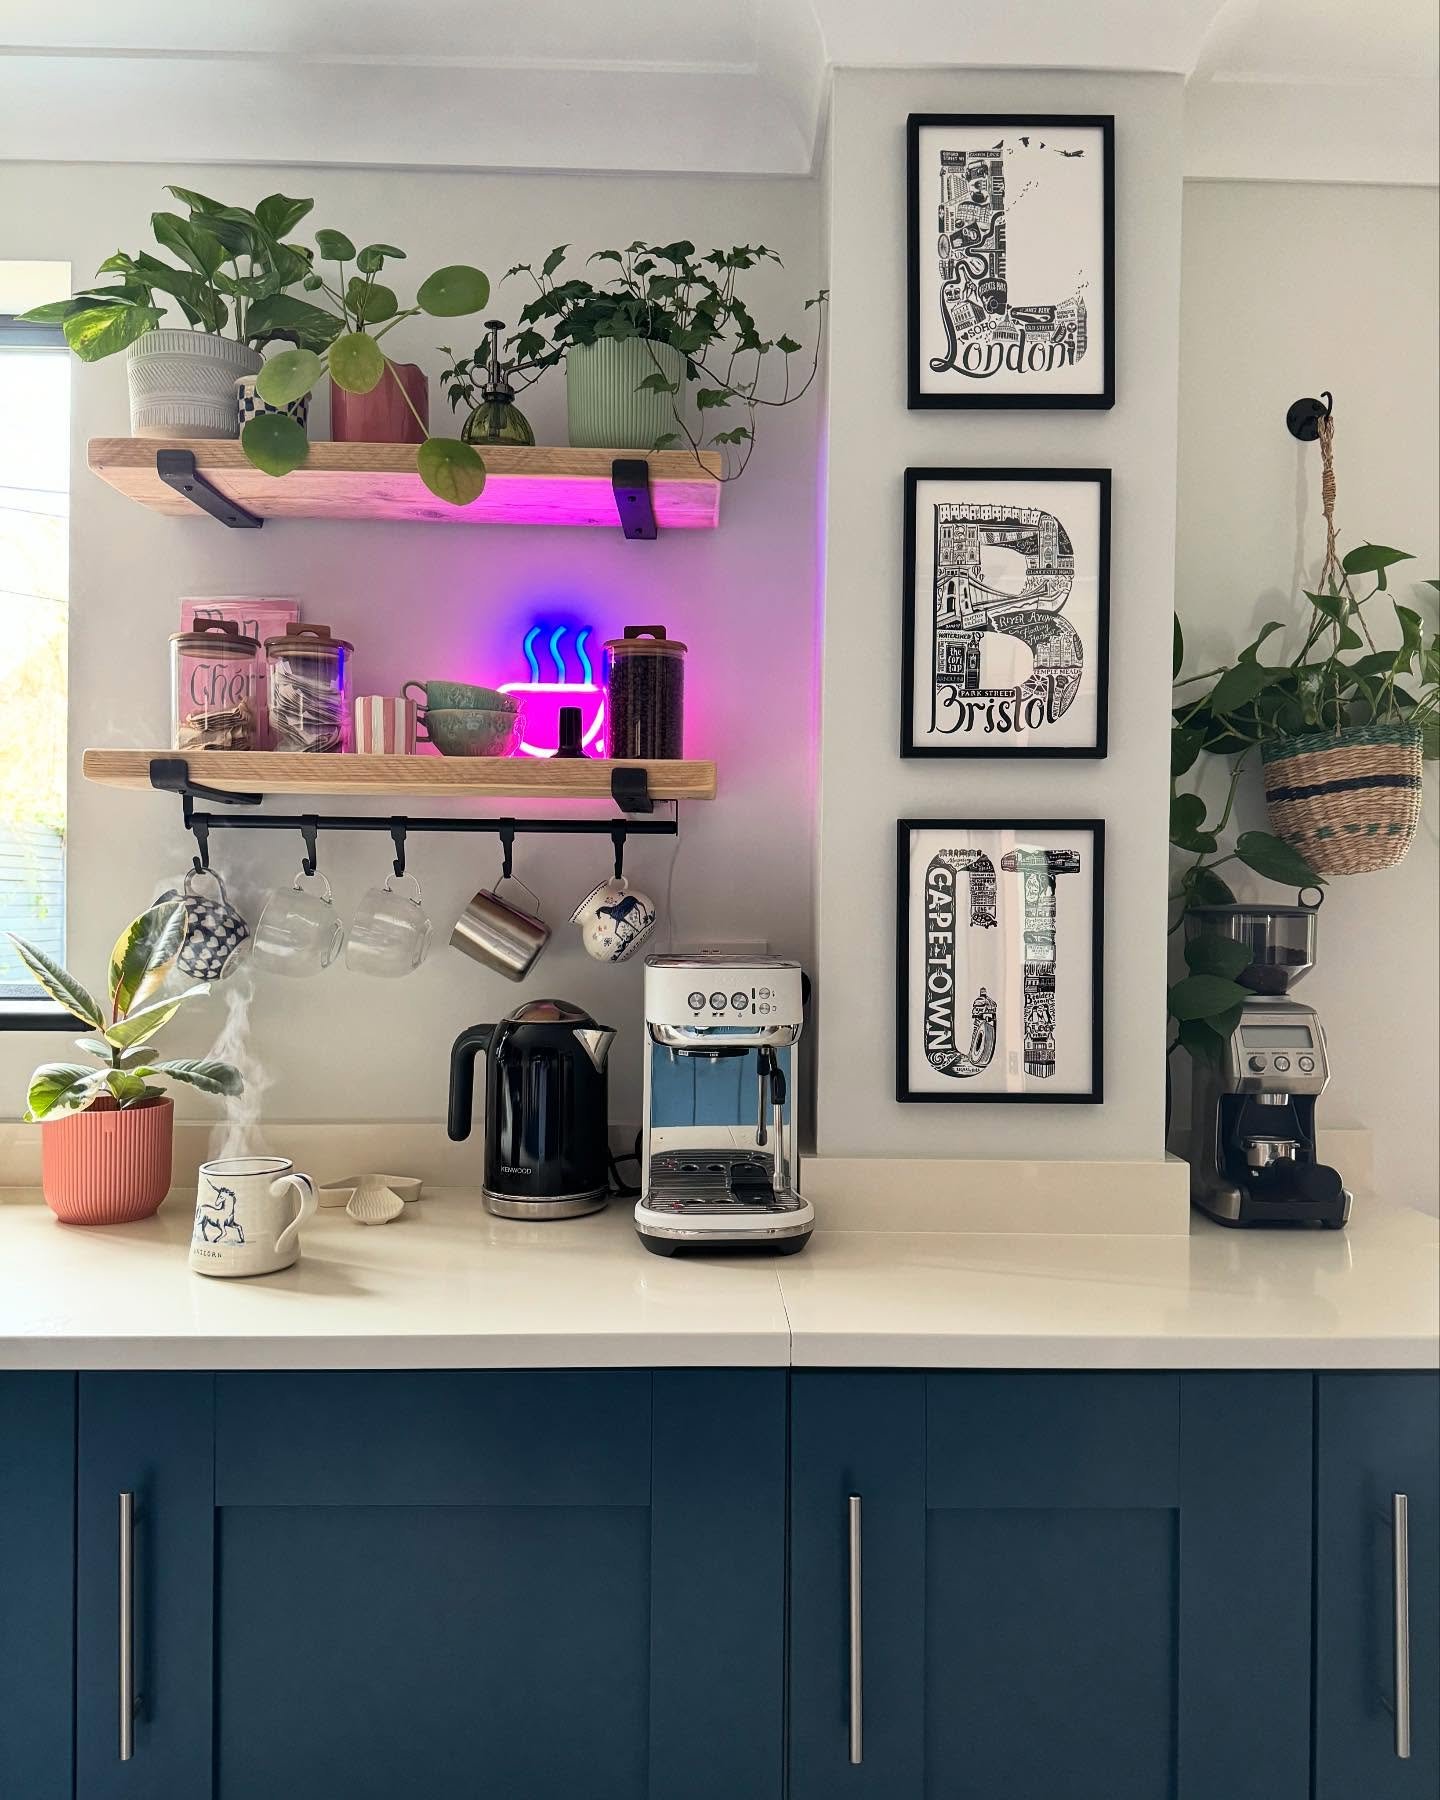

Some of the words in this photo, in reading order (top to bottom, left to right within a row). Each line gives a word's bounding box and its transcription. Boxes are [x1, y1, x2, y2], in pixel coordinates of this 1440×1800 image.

[967, 320, 997, 338] SOHO
[929, 318, 1067, 378] London
[1000, 613, 1025, 628] RIVER
[949, 647, 962, 656] the
[948, 664, 963, 673] tap
[927, 674, 1058, 734] Bristol
[928, 867, 953, 944] CAPE
[928, 954, 952, 1050] TOWN
[500, 1166, 532, 1175] KENWOOD
[193, 1248, 222, 1258] UNICORN
